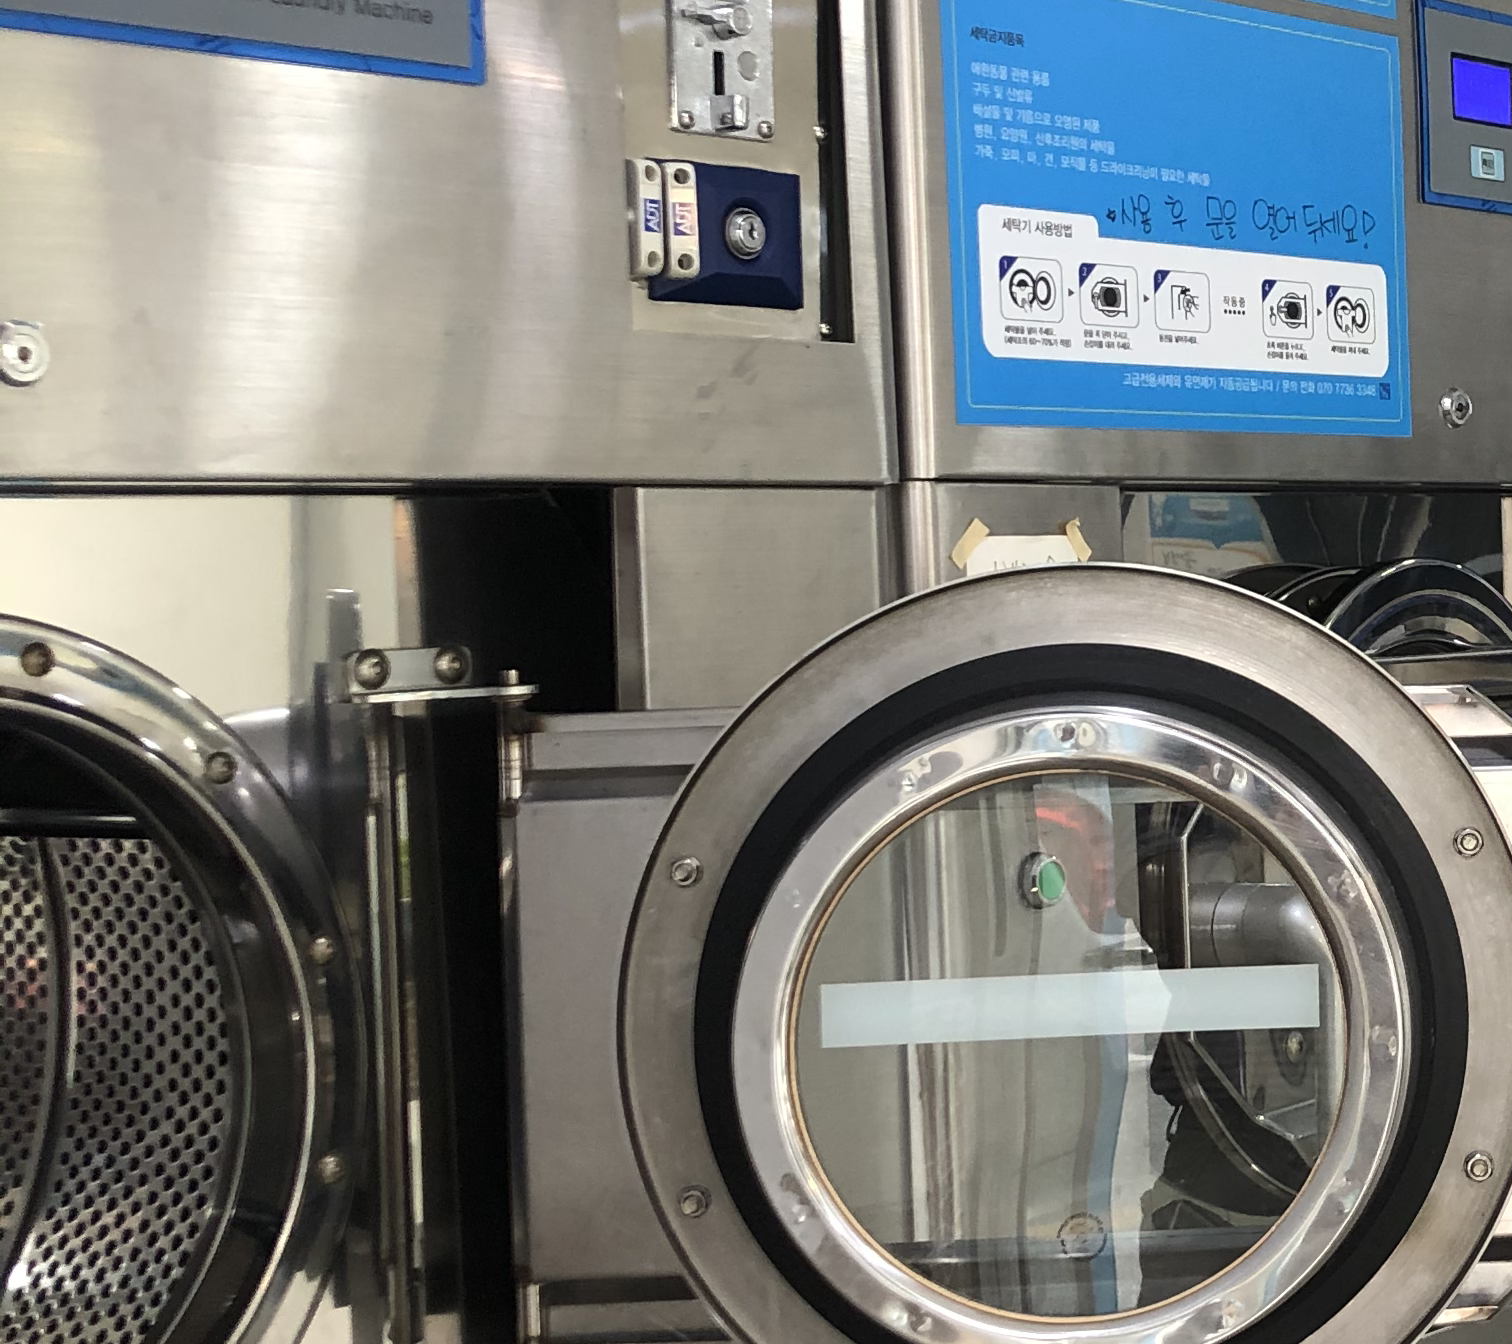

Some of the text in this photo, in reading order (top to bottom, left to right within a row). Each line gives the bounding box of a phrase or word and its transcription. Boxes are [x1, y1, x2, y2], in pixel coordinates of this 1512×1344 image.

[645, 199, 660, 232] ADT
[675, 203, 693, 235] ADT
[1001, 217, 1073, 238] 세탁기 사용방법
[1121, 193, 1151, 234] 사용
[1164, 194, 1187, 232] 후
[1206, 196, 1237, 241] 문을
[1252, 198, 1296, 241] 열어
[1219, 376, 1274, 393] 자동공급됩니다
[1317, 382, 1332, 395] 070
